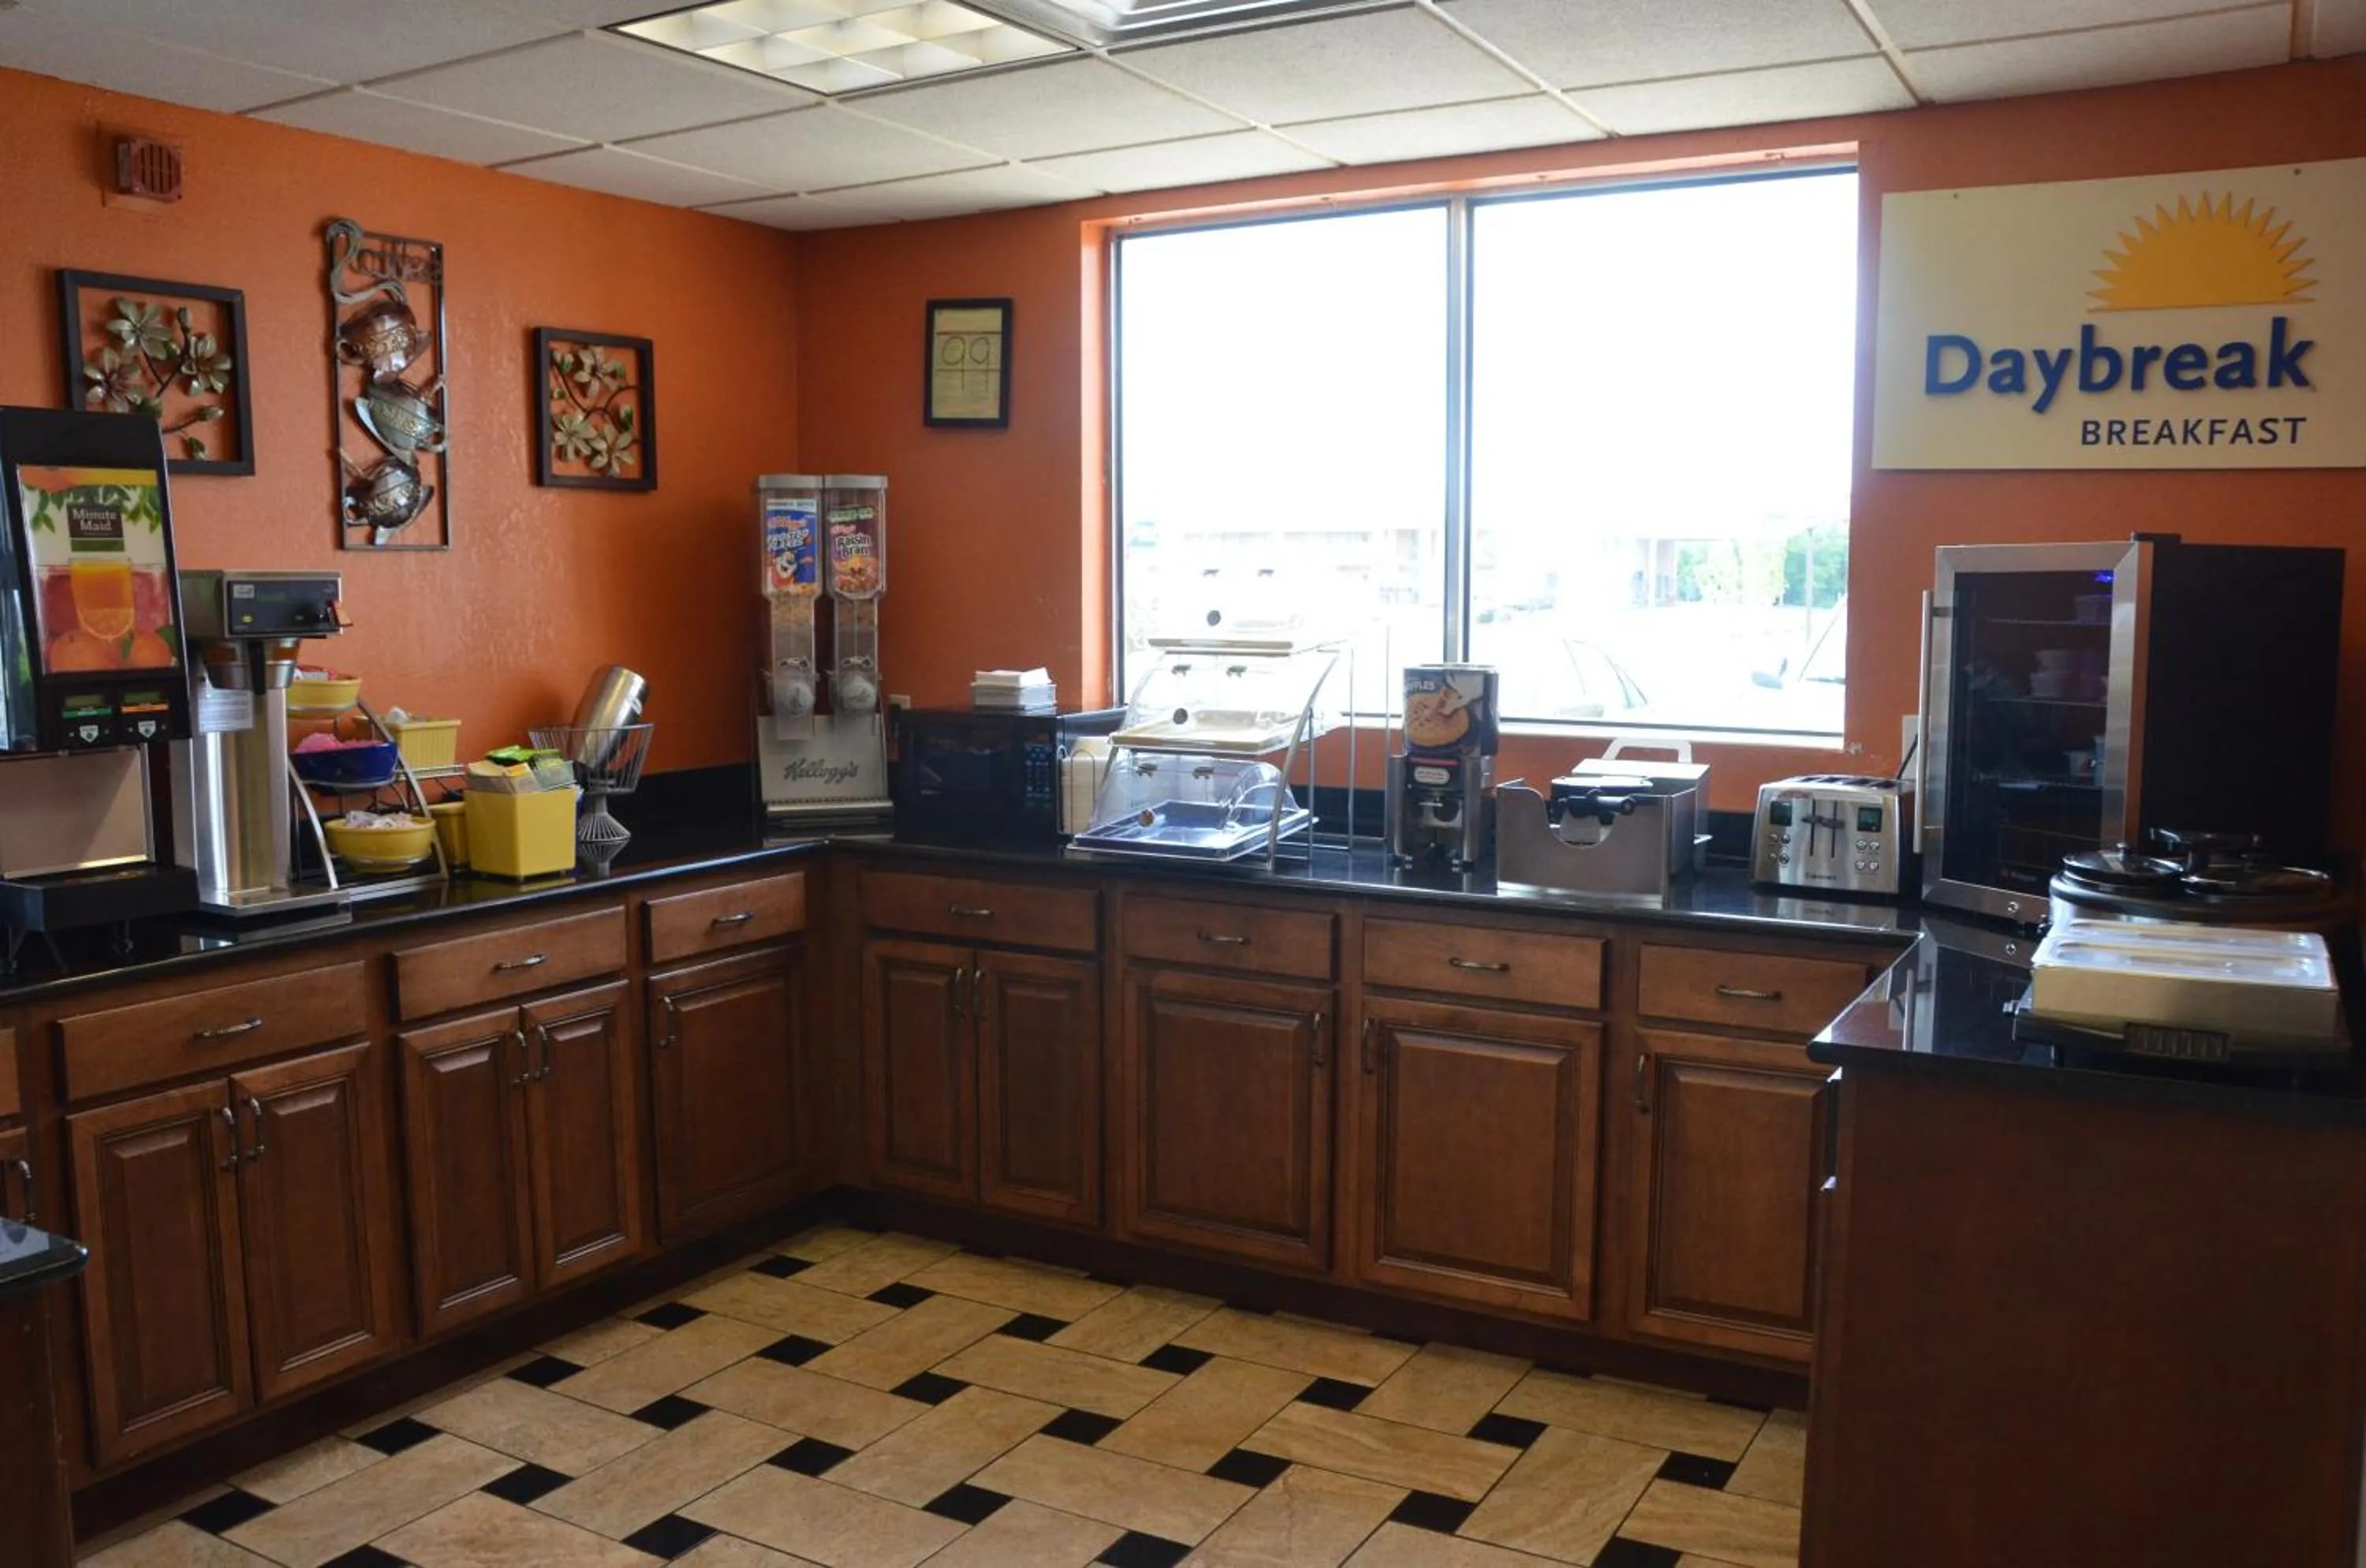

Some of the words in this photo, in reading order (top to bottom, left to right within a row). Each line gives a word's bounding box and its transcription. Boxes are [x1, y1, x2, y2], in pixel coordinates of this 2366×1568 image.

[1924, 316, 2316, 414] Daybreak
[2081, 416, 2307, 445] BREAKFAST
[73, 508, 118, 520] Minute
[80, 520, 113, 531] Maid
[783, 758, 859, 785] Kellogg's
